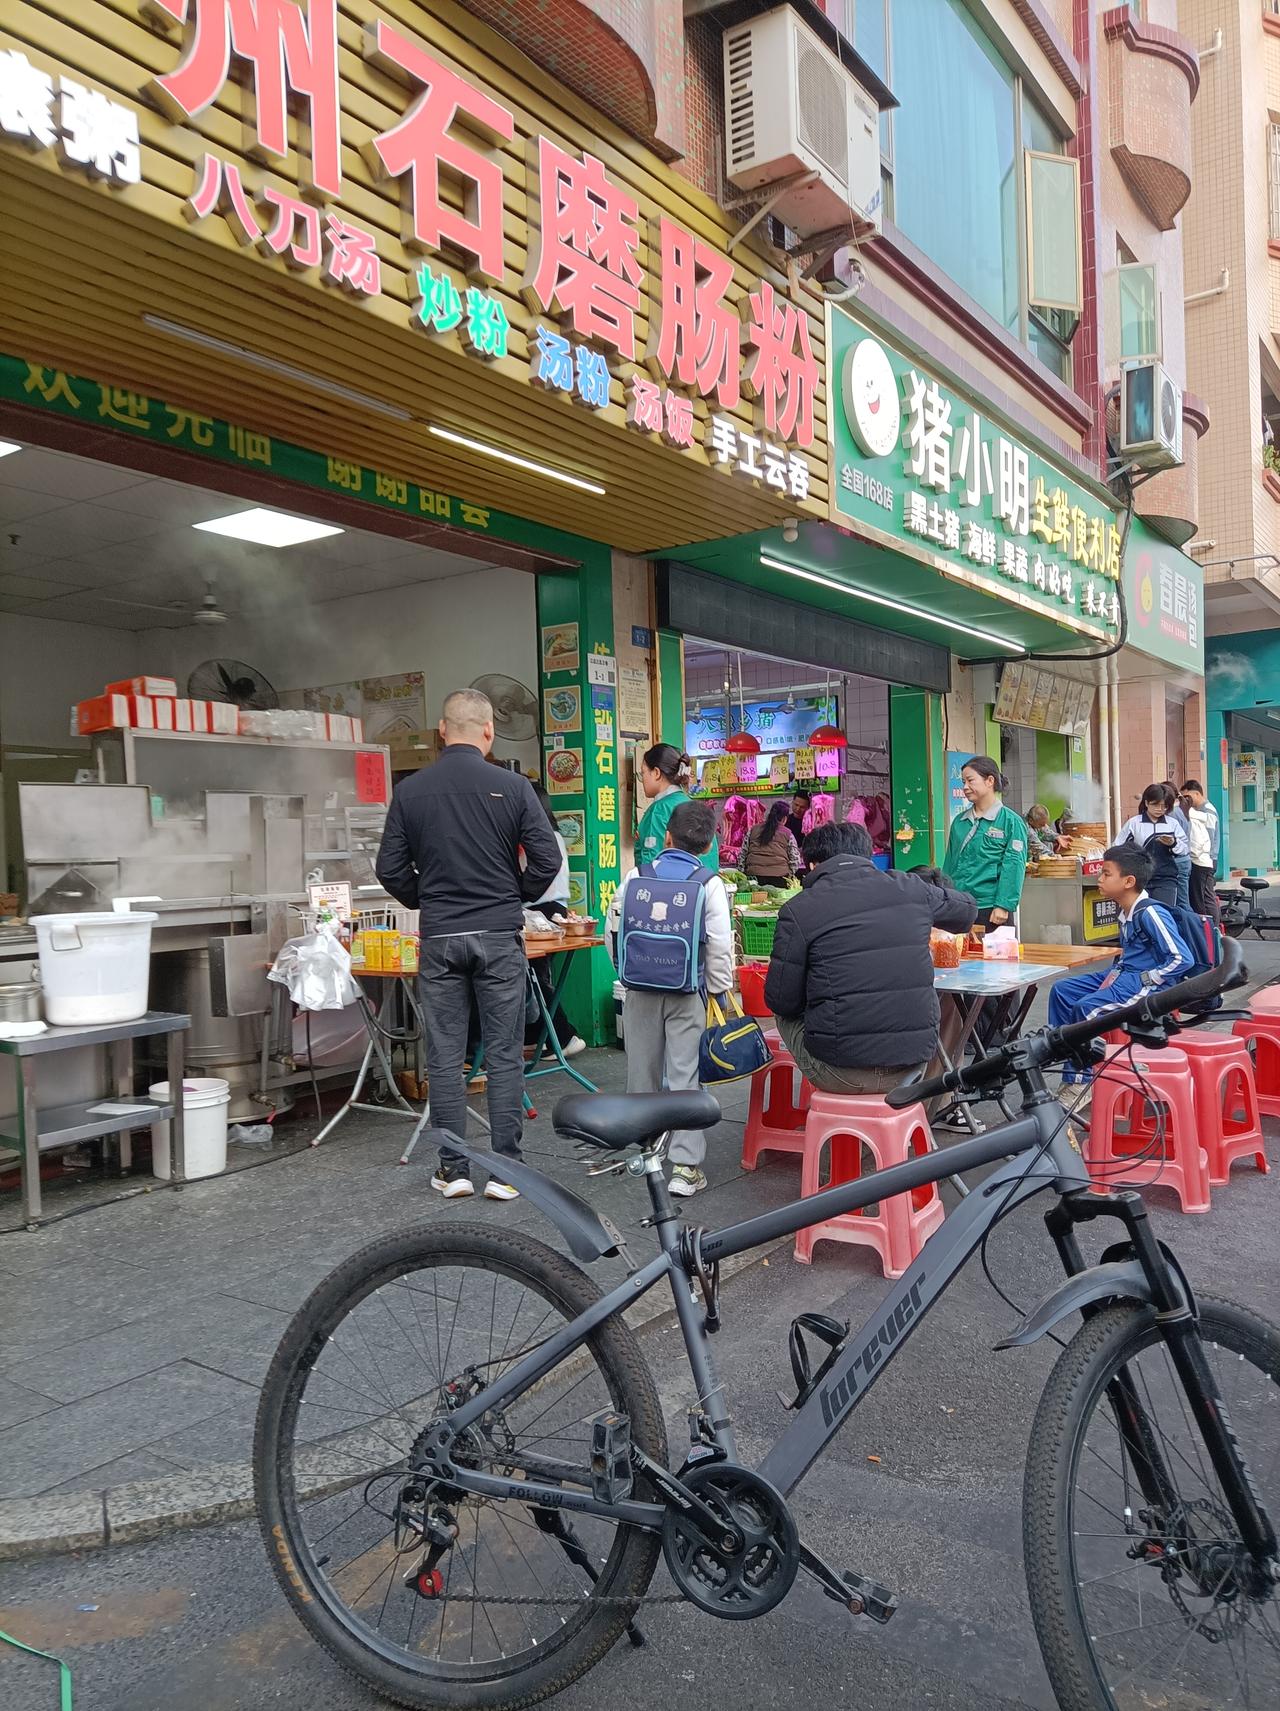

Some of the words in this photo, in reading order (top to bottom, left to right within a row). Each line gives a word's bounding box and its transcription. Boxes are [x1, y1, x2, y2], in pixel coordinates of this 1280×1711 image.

[150, 0, 818, 447] 州石磨肠粉
[190, 153, 381, 296] 八刀汤
[415, 261, 511, 358] 炒粉
[534, 326, 612, 408] 汤粉
[632, 373, 695, 448] 汤饭
[712, 415, 809, 500] 手工云吞
[841, 463, 894, 511] 全国168店
[908, 370, 1029, 536] 猪小明
[1032, 475, 1120, 580] 生鲜便利店
[910, 491, 960, 549] 黑土猪
[967, 520, 997, 566] 海鲜
[1002, 540, 1029, 583] 果蔬
[1033, 552, 1075, 604] 肉好吃
[653, 956, 678, 966] YUAN
[819, 1272, 926, 1428] forever
[508, 1486, 563, 1505] FOLLOW
